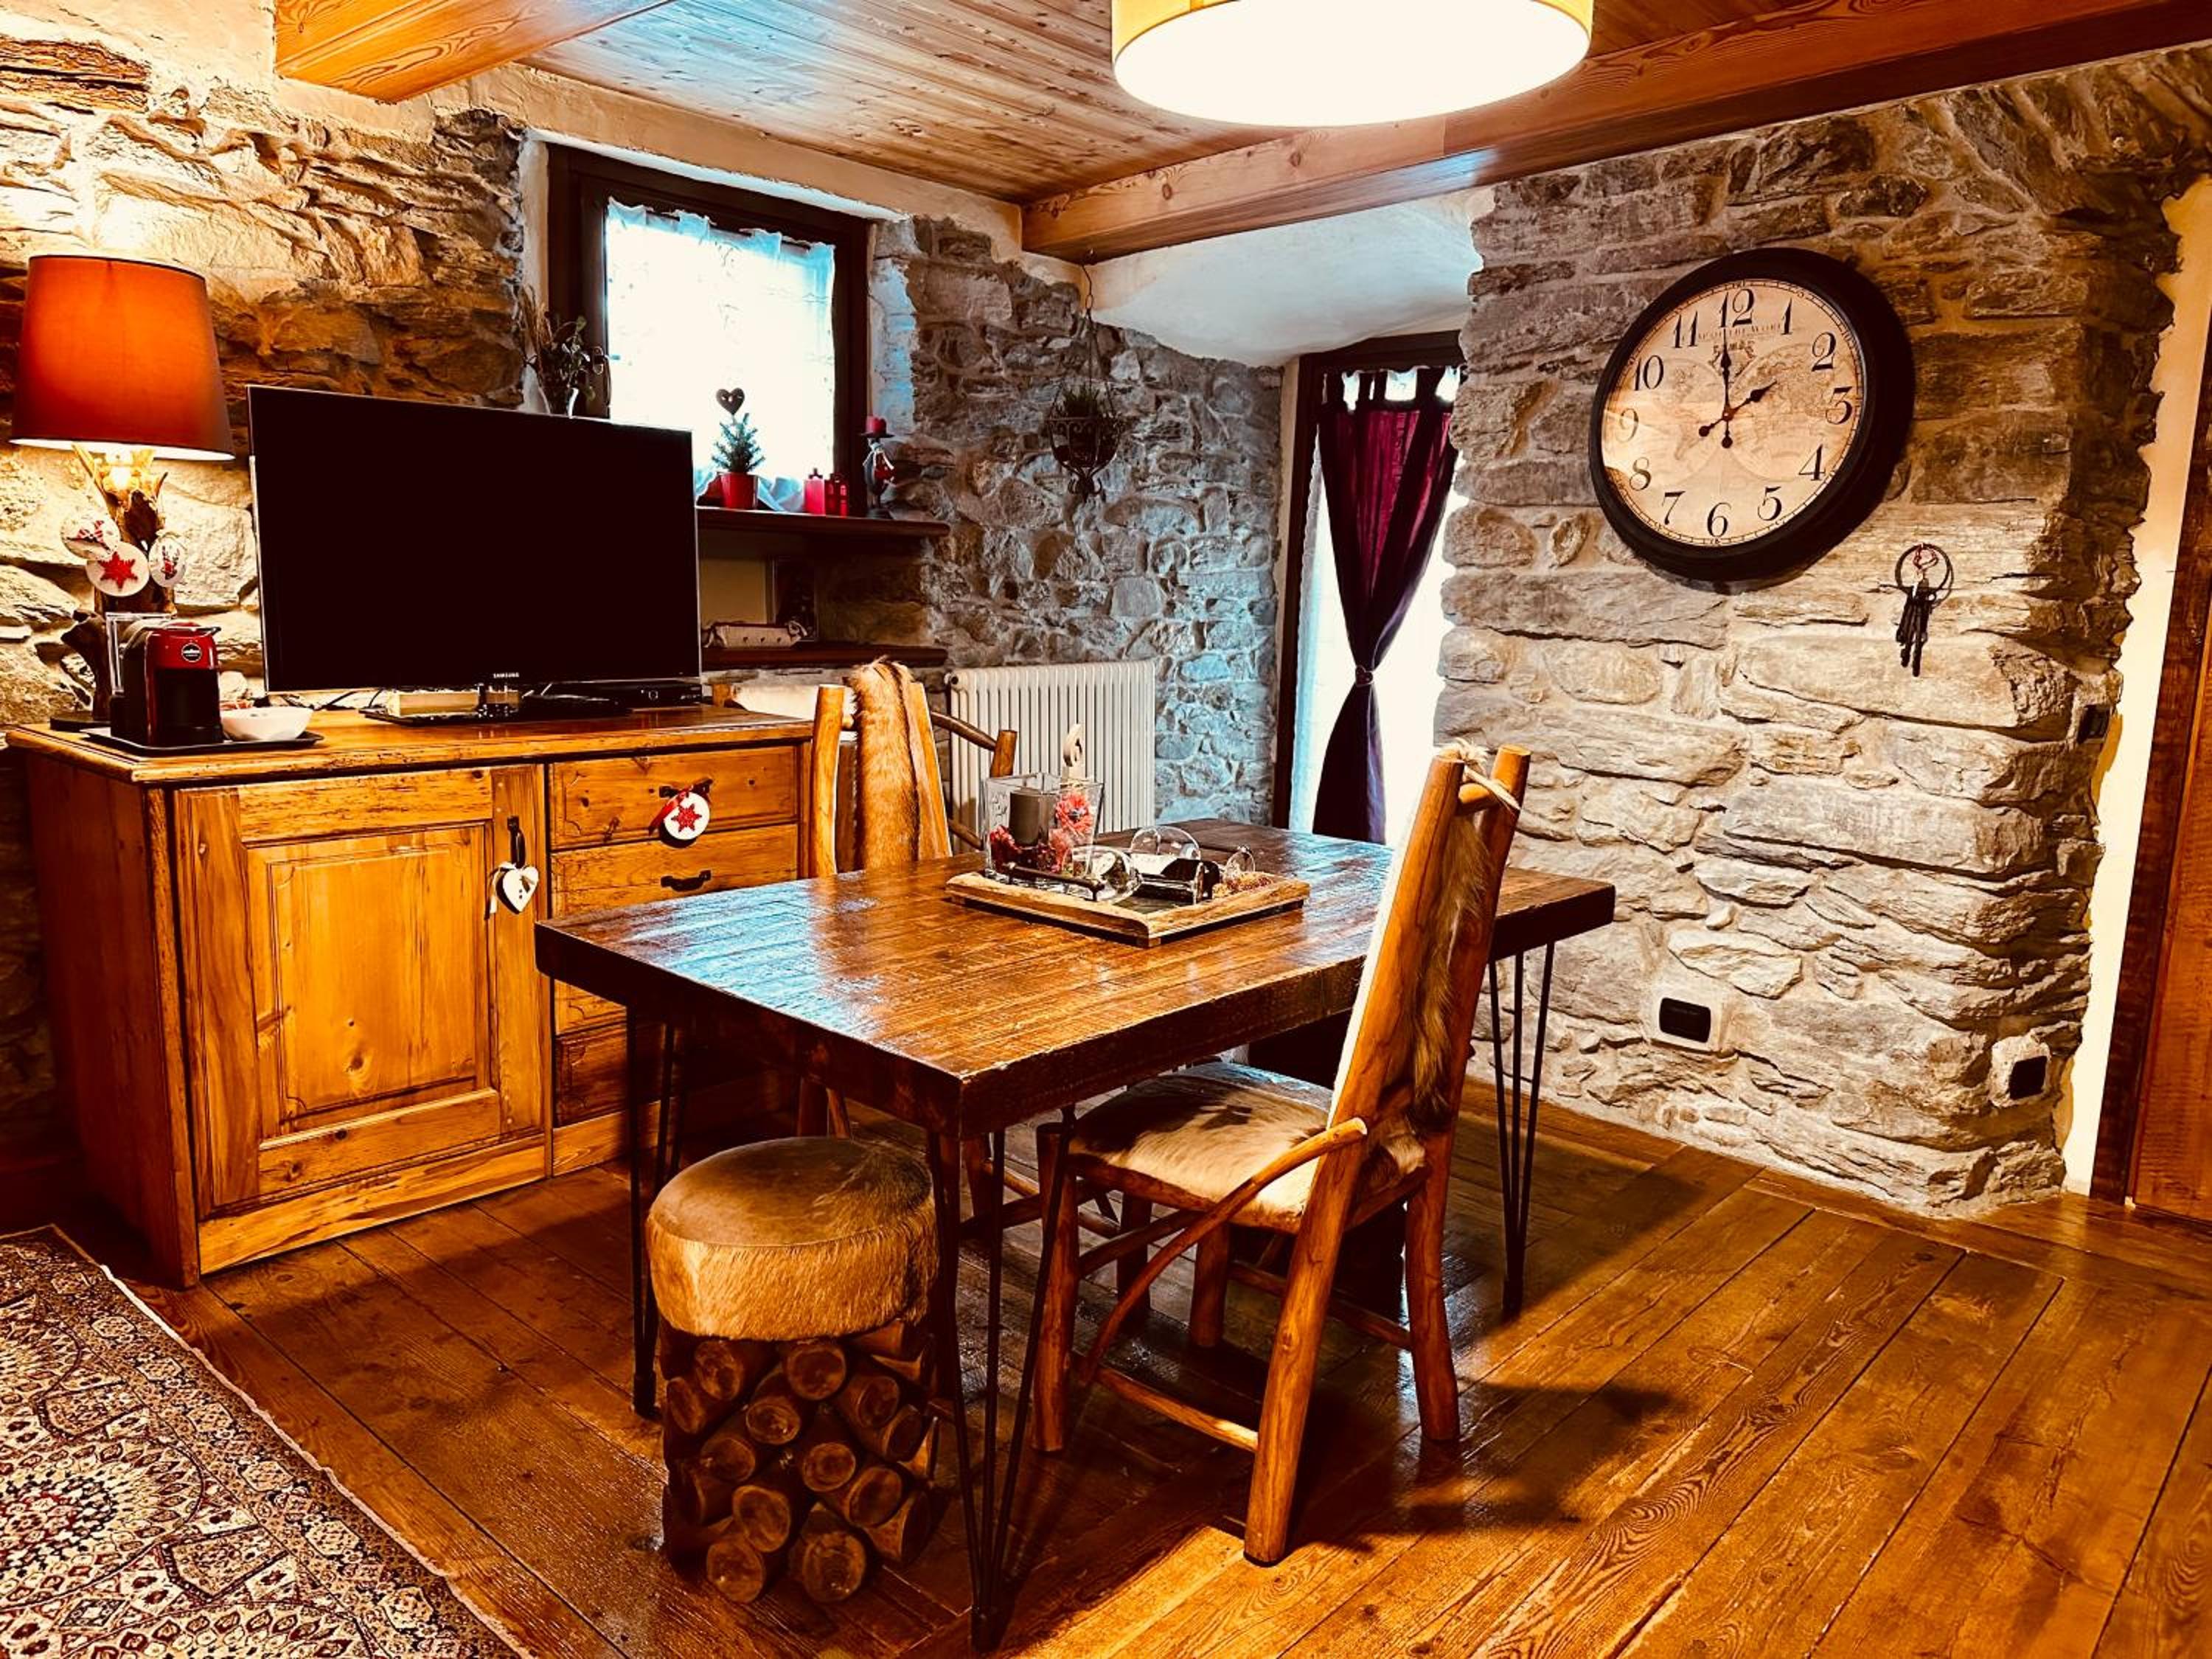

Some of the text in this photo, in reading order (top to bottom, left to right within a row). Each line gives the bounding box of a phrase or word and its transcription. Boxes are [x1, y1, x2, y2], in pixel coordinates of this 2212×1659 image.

[1718, 288, 1754, 327] 12
[1781, 297, 1792, 335] 1
[1672, 310, 1698, 348] 11
[1811, 331, 1836, 372] 2
[1634, 355, 1664, 391] 10
[1825, 386, 1853, 425] 3
[1616, 408, 1639, 442] 9
[1629, 456, 1652, 491] 8
[1798, 444, 1826, 481] 4
[1661, 490, 1686, 525] 7
[1707, 501, 1731, 538] 6
[1757, 486, 1782, 521] 5
